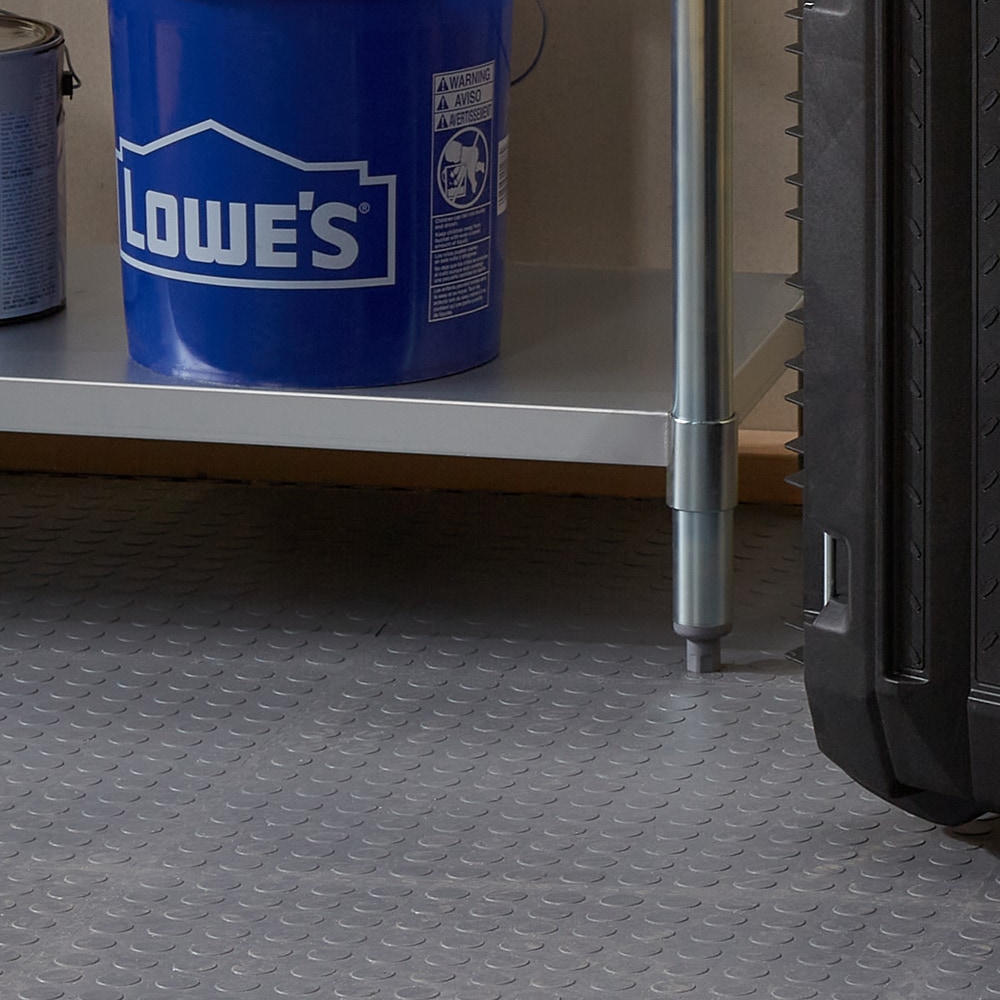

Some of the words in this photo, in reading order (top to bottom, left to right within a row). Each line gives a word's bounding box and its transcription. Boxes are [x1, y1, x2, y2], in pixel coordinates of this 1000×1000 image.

[449, 67, 491, 90] WARNING
[454, 89, 482, 107] AVISO
[449, 103, 492, 127] AVERTISSEMENT
[123, 167, 359, 270] LOWE'S
